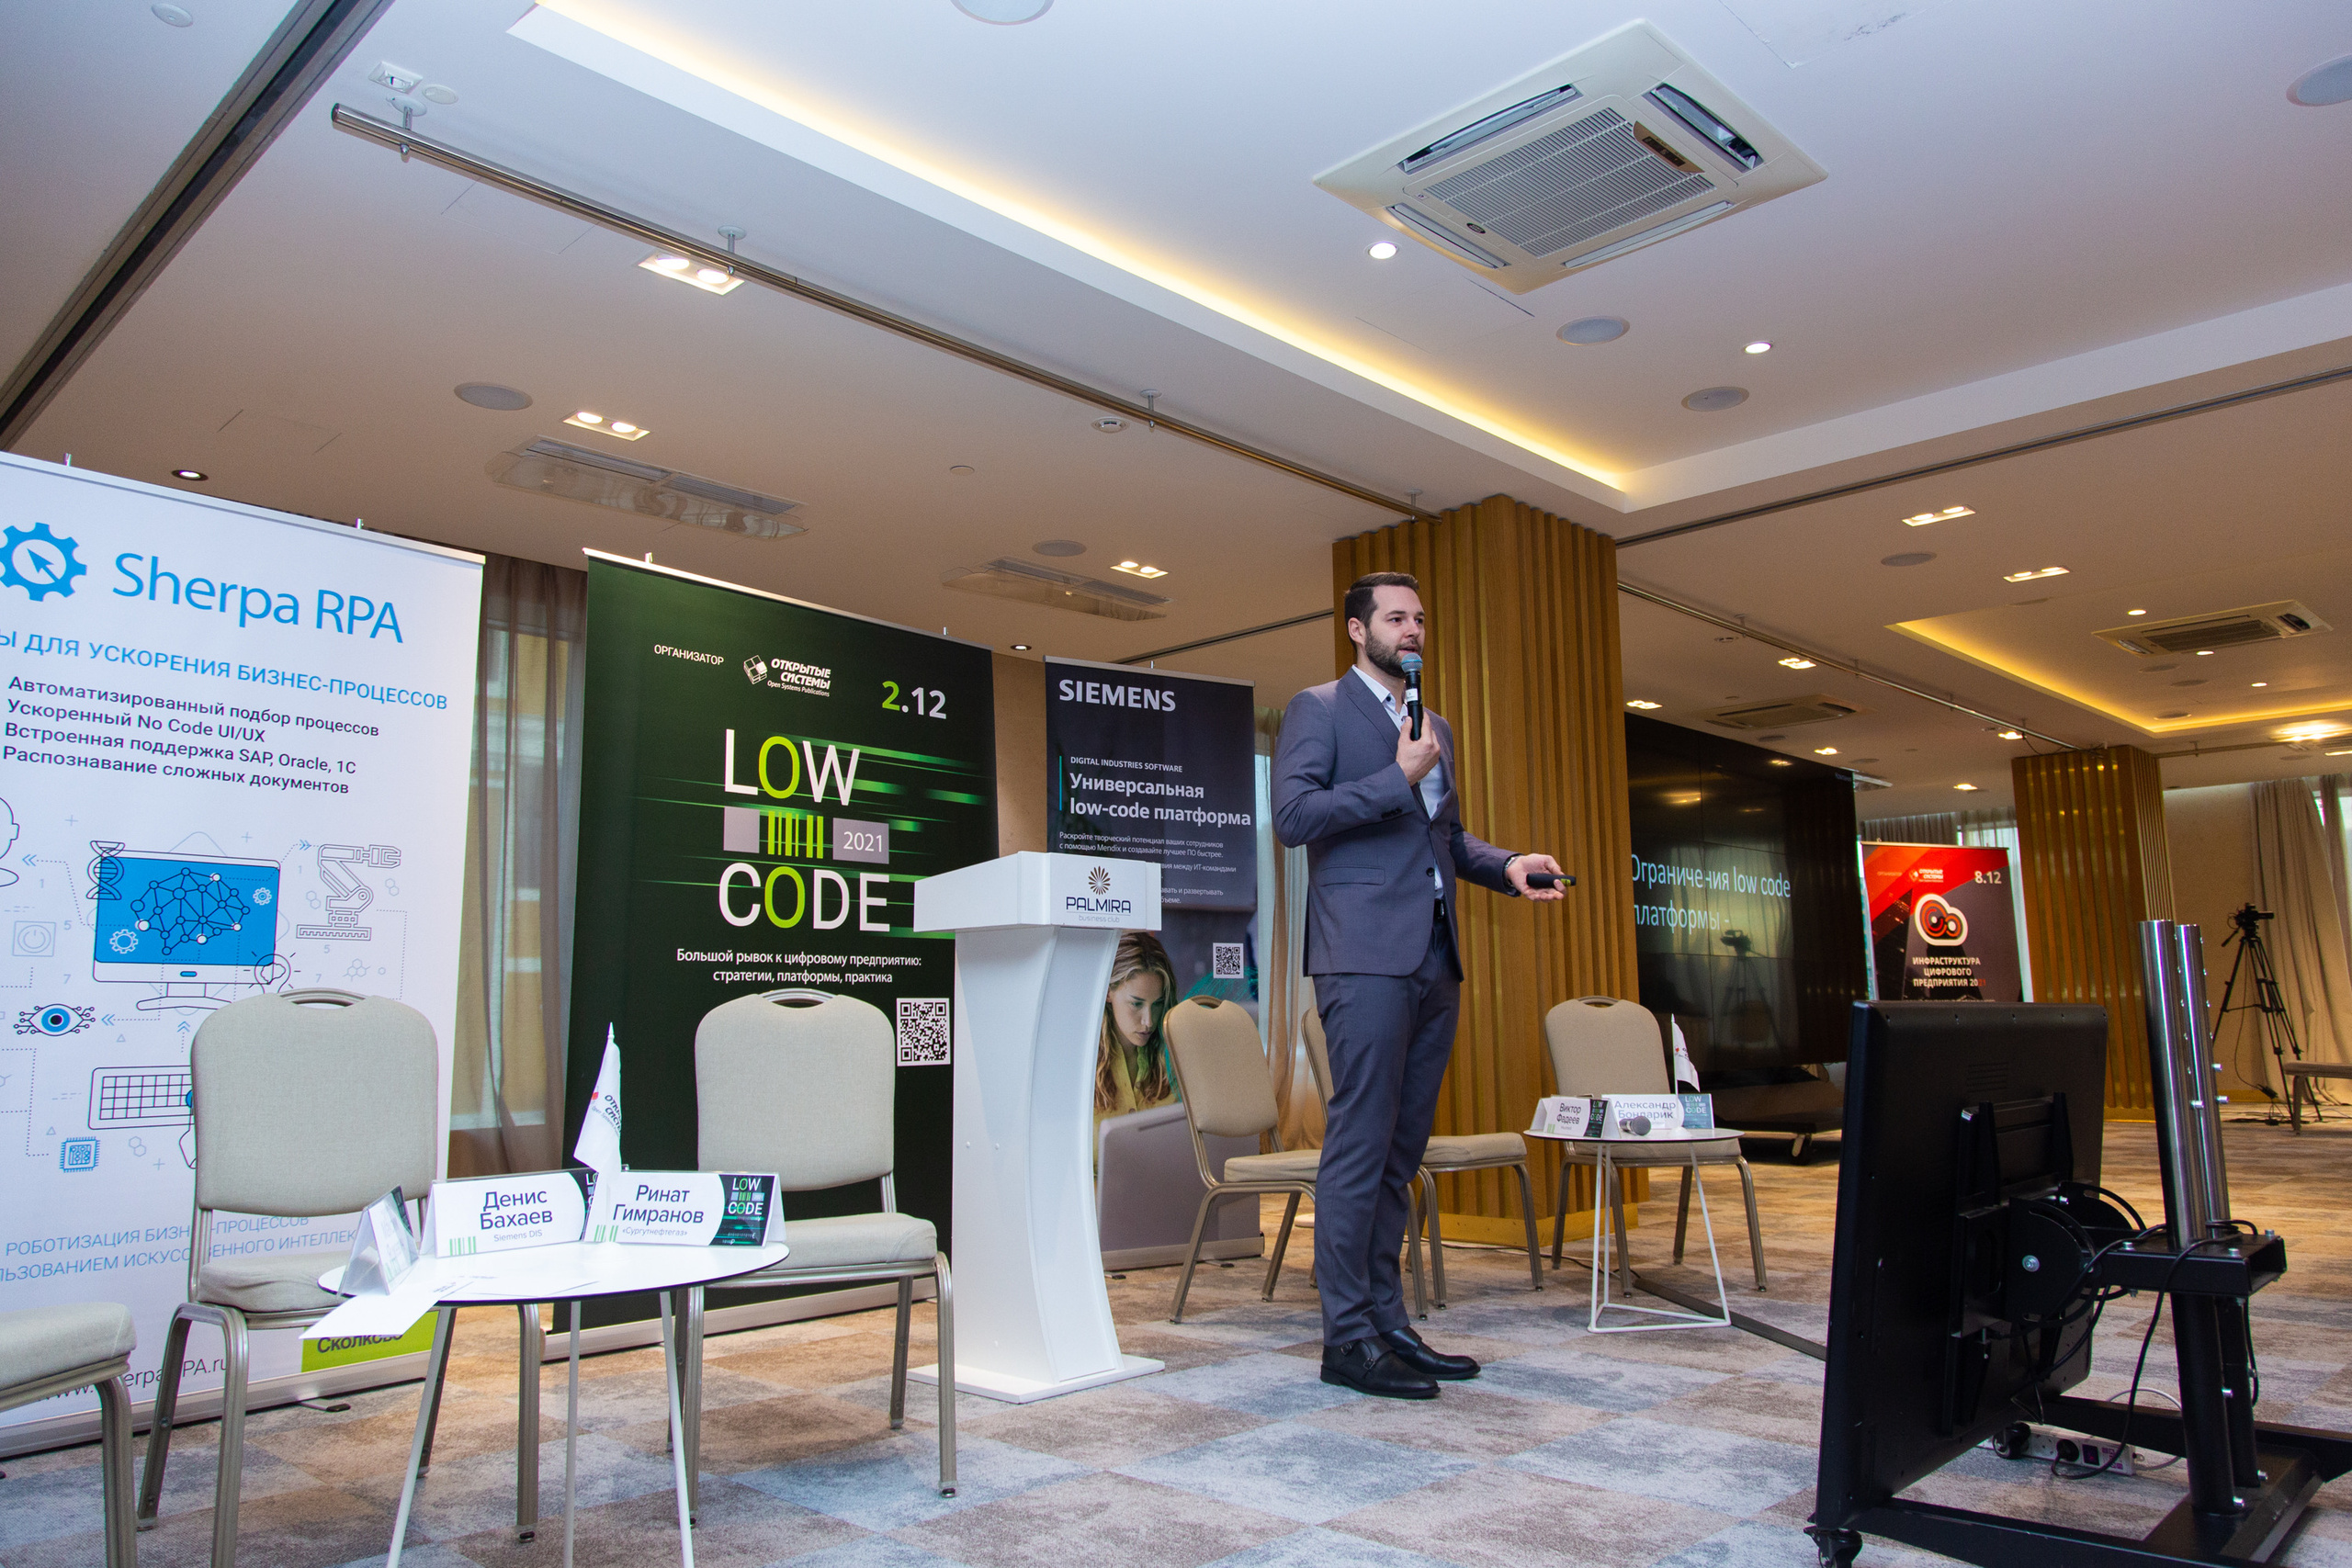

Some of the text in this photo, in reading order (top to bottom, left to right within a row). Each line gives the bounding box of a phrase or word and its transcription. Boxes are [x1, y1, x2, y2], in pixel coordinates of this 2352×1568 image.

[112, 552, 403, 643] Sherpa RPA
[654, 644, 724, 665] ОРГАНИЗАТОР
[24, 634, 80, 657] ДЛЯ
[88, 642, 231, 678] УСКОРЕНИЯ
[237, 664, 447, 709] БИЗНЕС-ПРОЦЕССОВ
[771, 658, 831, 678] ОТКРЫТЫЕ
[767, 680, 830, 697] Open Systems Publications
[780, 671, 831, 690] СИСТЕМЫ
[881, 681, 947, 720] 2.12
[1058, 679, 1176, 712] SIEMENS
[8, 676, 379, 737] Автоматизированный подбор процессов
[7, 698, 266, 743] Ускоренный No Code UI/UX
[6, 722, 124, 749] Встроенная
[130, 739, 233, 761] поддержка
[239, 749, 274, 767] SAP,
[278, 753, 332, 773] Oracle,
[4, 746, 349, 794] Распознавание сложных документов
[724, 728, 860, 807] LOW
[1070, 756, 1183, 773] DIGITAL INDUSTRIES SOFTWARE
[1069, 773, 1204, 798] Универсальная
[1069, 797, 1251, 828] low-code платформа
[843, 831, 882, 852] 2021
[1058, 831, 1093, 842] Раскройте
[1094, 834, 1131, 843] творческий
[1132, 837, 1165, 845] потенциал
[1185, 840, 1224, 849] сотрудников
[1064, 843, 1096, 852] помощью
[1097, 843, 1121, 852] Mendix
[1127, 846, 1162, 854] создавайте
[1197, 851, 1224, 859] быстрее.
[1733, 865, 1757, 894] low
[1760, 872, 1791, 897] code
[1974, 871, 2002, 885] 8.12
[718, 863, 890, 931] CODE
[1066, 897, 1131, 914] PALMIRA
[1079, 915, 1106, 923] business
[1634, 899, 1720, 935] платформы
[676, 948, 922, 967] Большой рывок к цифровому предприятию:
[1912, 957, 1981, 965] ИНФРАСТРУКТУРА
[713, 970, 892, 985] стратегии, платформы, практика
[1924, 968, 1972, 977] ЦИФРОВОГО
[1913, 978, 1968, 988] ПРЕДПРИЯТИЯ
[1559, 1102, 1581, 1114] Виктор
[1614, 1100, 1676, 1111] Александр
[1556, 1113, 1580, 1124] Фадеев
[635, 1184, 690, 1202] Ринат
[732, 1178, 762, 1191] LOW
[482, 1190, 548, 1212] Денис
[728, 1201, 763, 1215] CODE
[480, 1210, 553, 1230] Бахаев
[612, 1204, 705, 1226] Гимранов
[278, 1229, 356, 1250] ИНТЕЛЛЕК
[493, 1229, 543, 1242] Siemens DIS
[622, 1226, 688, 1236] «Сургутнефтегаз»
[6, 1230, 141, 1257] РОБОТИЗАЦИЯ
